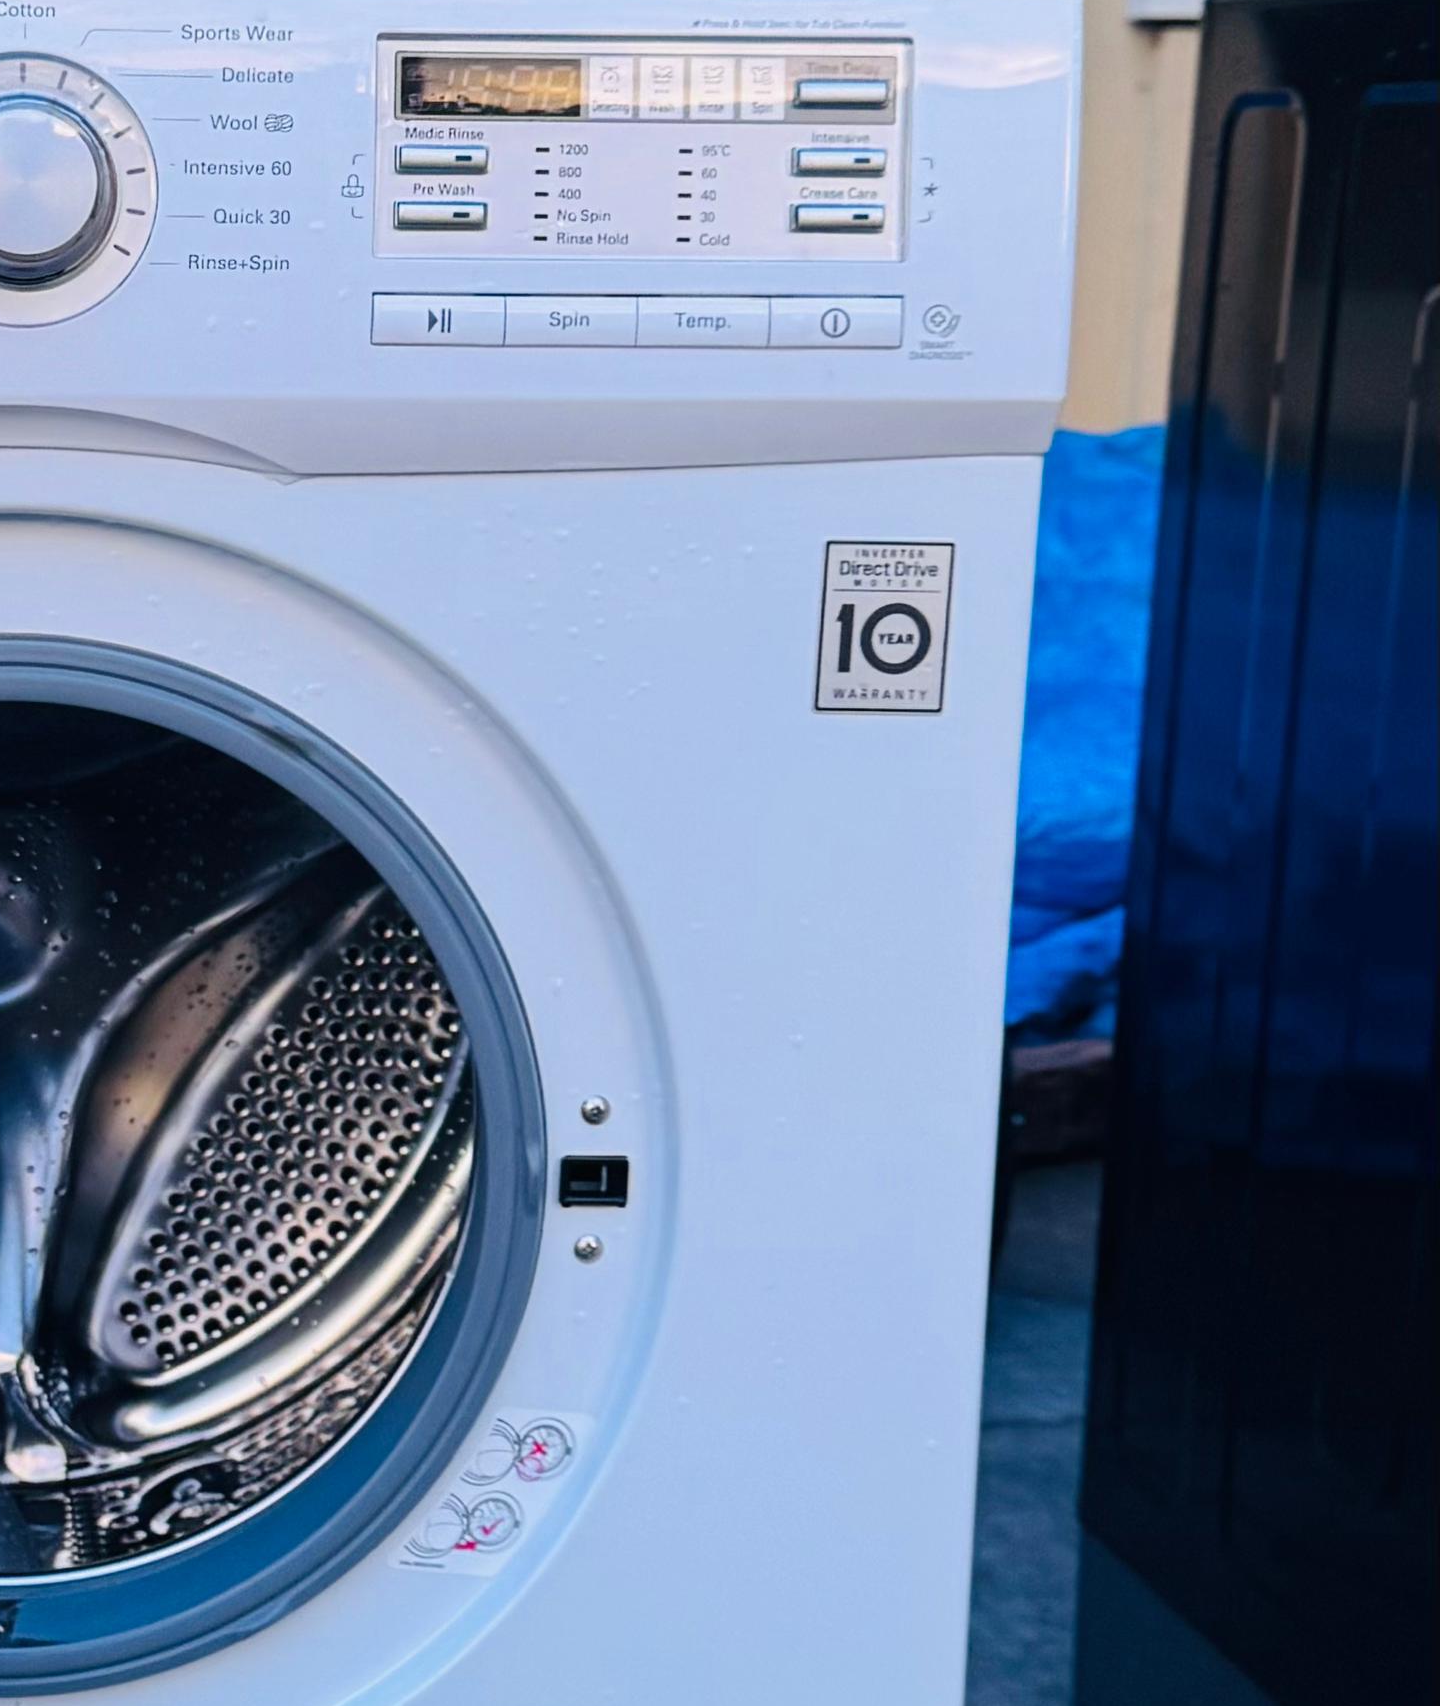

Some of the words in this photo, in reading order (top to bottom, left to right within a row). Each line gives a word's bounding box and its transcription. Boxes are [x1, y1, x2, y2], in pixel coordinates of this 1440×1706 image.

[181, 26, 241, 45] Sports
[246, 27, 294, 42] Wear
[221, 68, 294, 84] Delicate
[211, 115, 259, 131] Wool
[405, 127, 445, 140] Medic
[448, 128, 484, 140] Rinse
[811, 132, 870, 144] Intensive
[559, 145, 589, 155] 1200
[183, 160, 266, 177] Intensive
[271, 160, 293, 177] 60
[558, 167, 582, 178] 800
[701, 168, 718, 179] 60
[413, 183, 434, 196] Pre
[438, 184, 475, 196] Wash
[558, 189, 581, 199] 400
[700, 190, 717, 201] 40
[799, 187, 844, 199] Crease
[848, 188, 878, 199] Care
[213, 208, 264, 226] Quick
[269, 209, 291, 225] 30
[556, 210, 577, 222] No
[580, 210, 611, 223] Spin
[700, 212, 715, 223] 30
[556, 233, 594, 245] Rinse
[597, 233, 629, 245] Hold
[699, 234, 730, 246] Cold
[188, 255, 290, 274] Rinse+Spin
[548, 311, 590, 328] Spin
[674, 312, 733, 330] Temp.
[855, 549, 925, 558] INVERTER
[840, 560, 890, 576] Direct
[895, 561, 939, 577] Drive
[854, 579, 923, 587] MOTOR
[836, 602, 932, 675] 10
[878, 633, 914, 645] YEAR
[833, 688, 928, 700] WARRANTY
